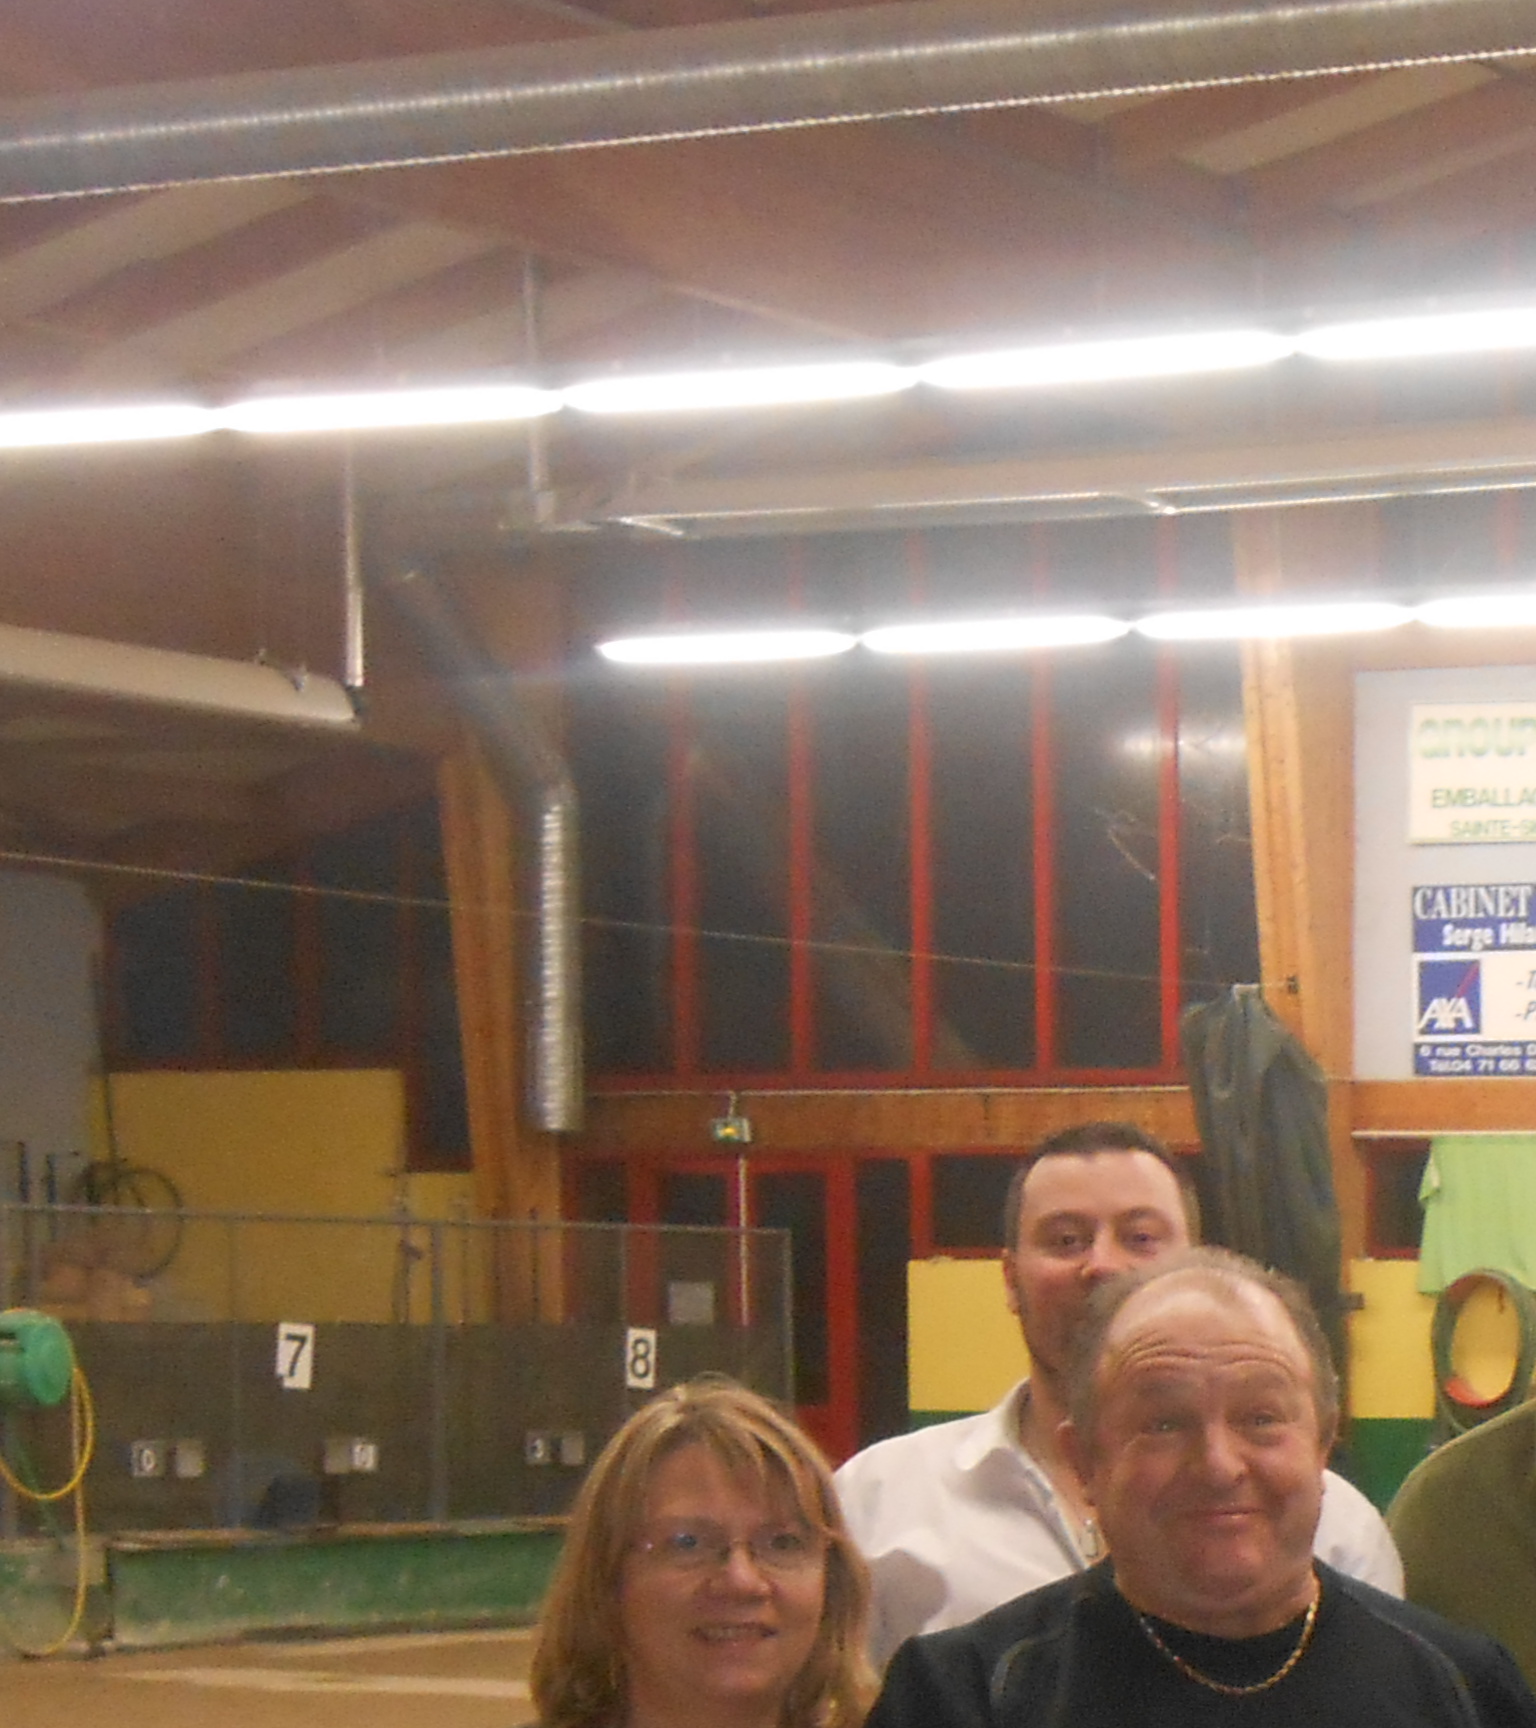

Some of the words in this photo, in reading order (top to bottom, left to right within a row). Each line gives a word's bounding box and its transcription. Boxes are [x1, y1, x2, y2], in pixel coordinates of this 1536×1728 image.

[1413, 886, 1531, 920] CABINET
[1442, 923, 1493, 949] Serge
[1418, 997, 1473, 1030] AXA
[285, 1333, 308, 1378] 7
[629, 1337, 651, 1380] 8
